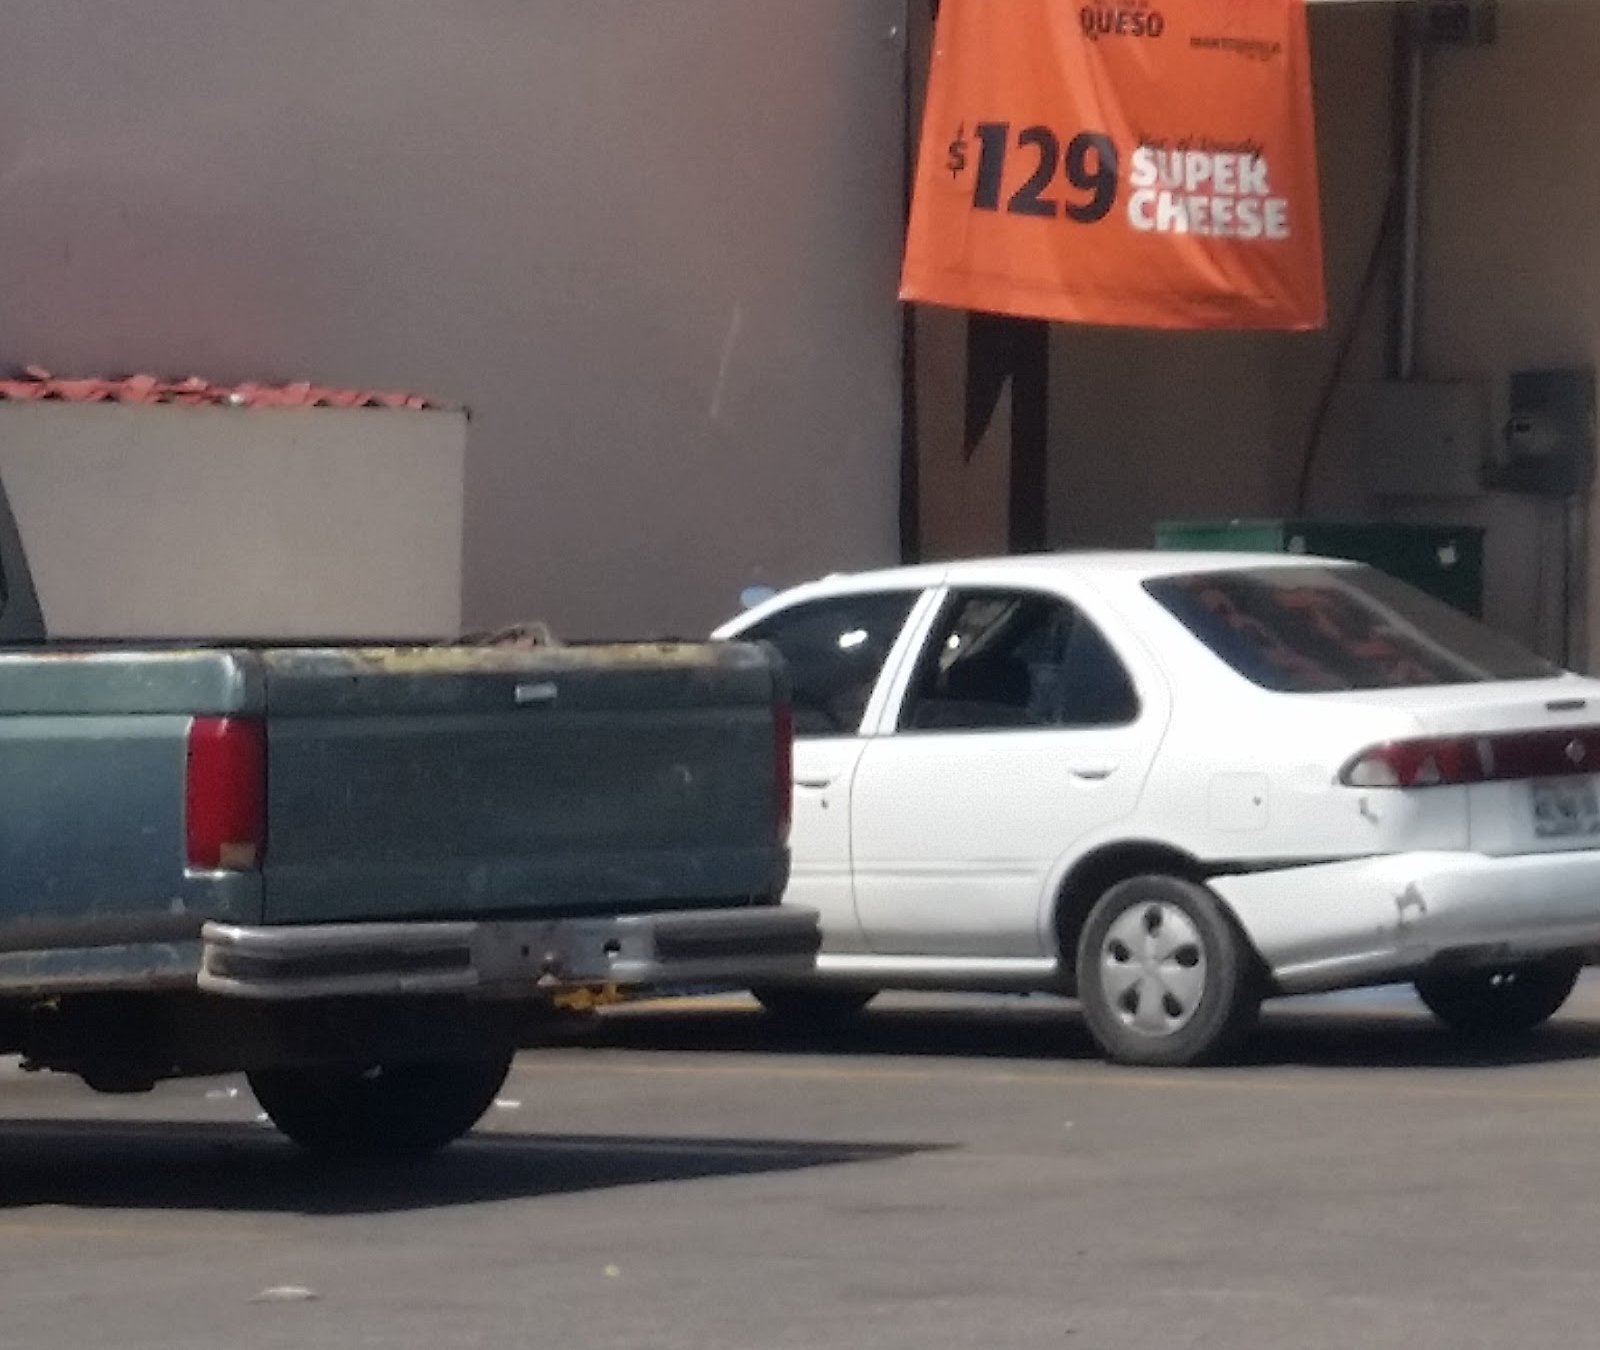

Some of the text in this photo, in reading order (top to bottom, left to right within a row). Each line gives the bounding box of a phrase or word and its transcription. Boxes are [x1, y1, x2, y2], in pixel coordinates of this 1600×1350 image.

[1080, 7, 1165, 40] QUESO
[1130, 147, 1270, 196] SUPER
[1127, 188, 1290, 238] CHEESE
